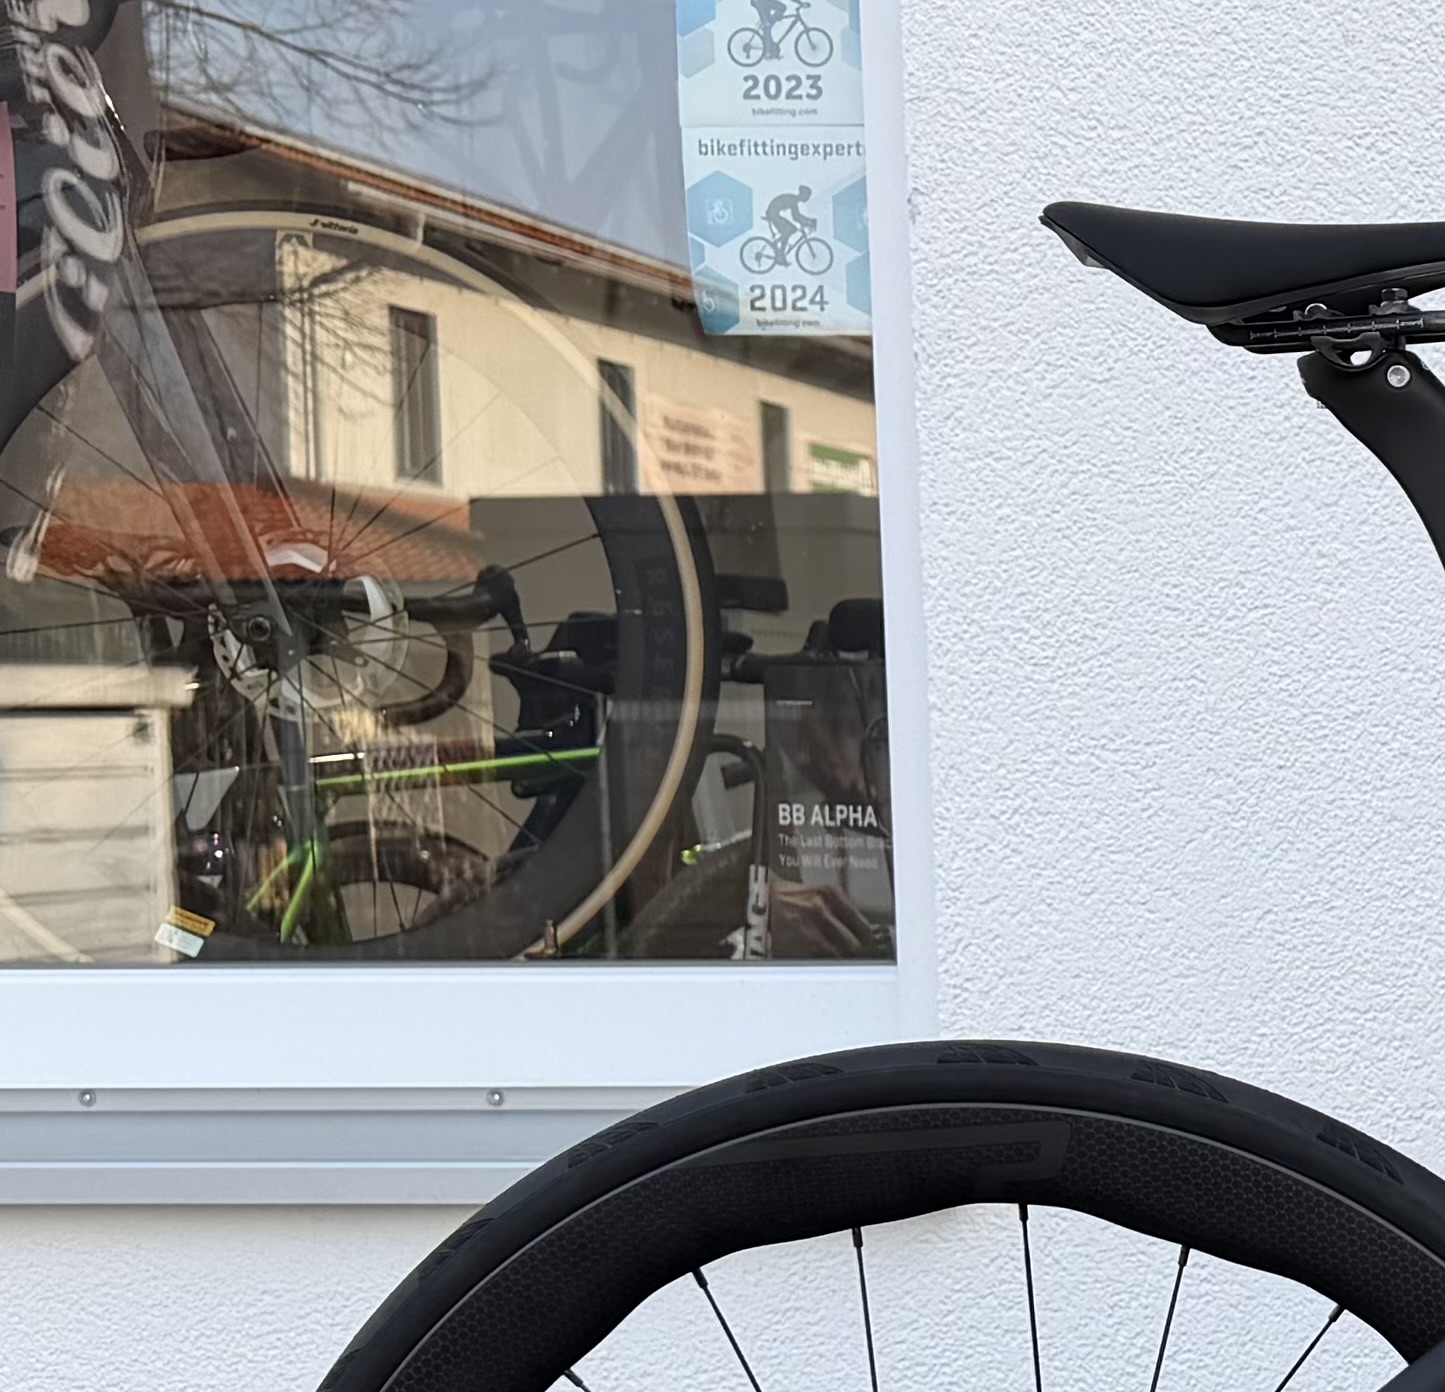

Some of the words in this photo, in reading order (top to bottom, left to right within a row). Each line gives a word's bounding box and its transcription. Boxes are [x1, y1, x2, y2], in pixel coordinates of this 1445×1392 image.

[742, 74, 823, 101] 2023
[749, 285, 829, 312] 2024
[778, 803, 806, 826] BB
[811, 803, 878, 827] ALPHA
